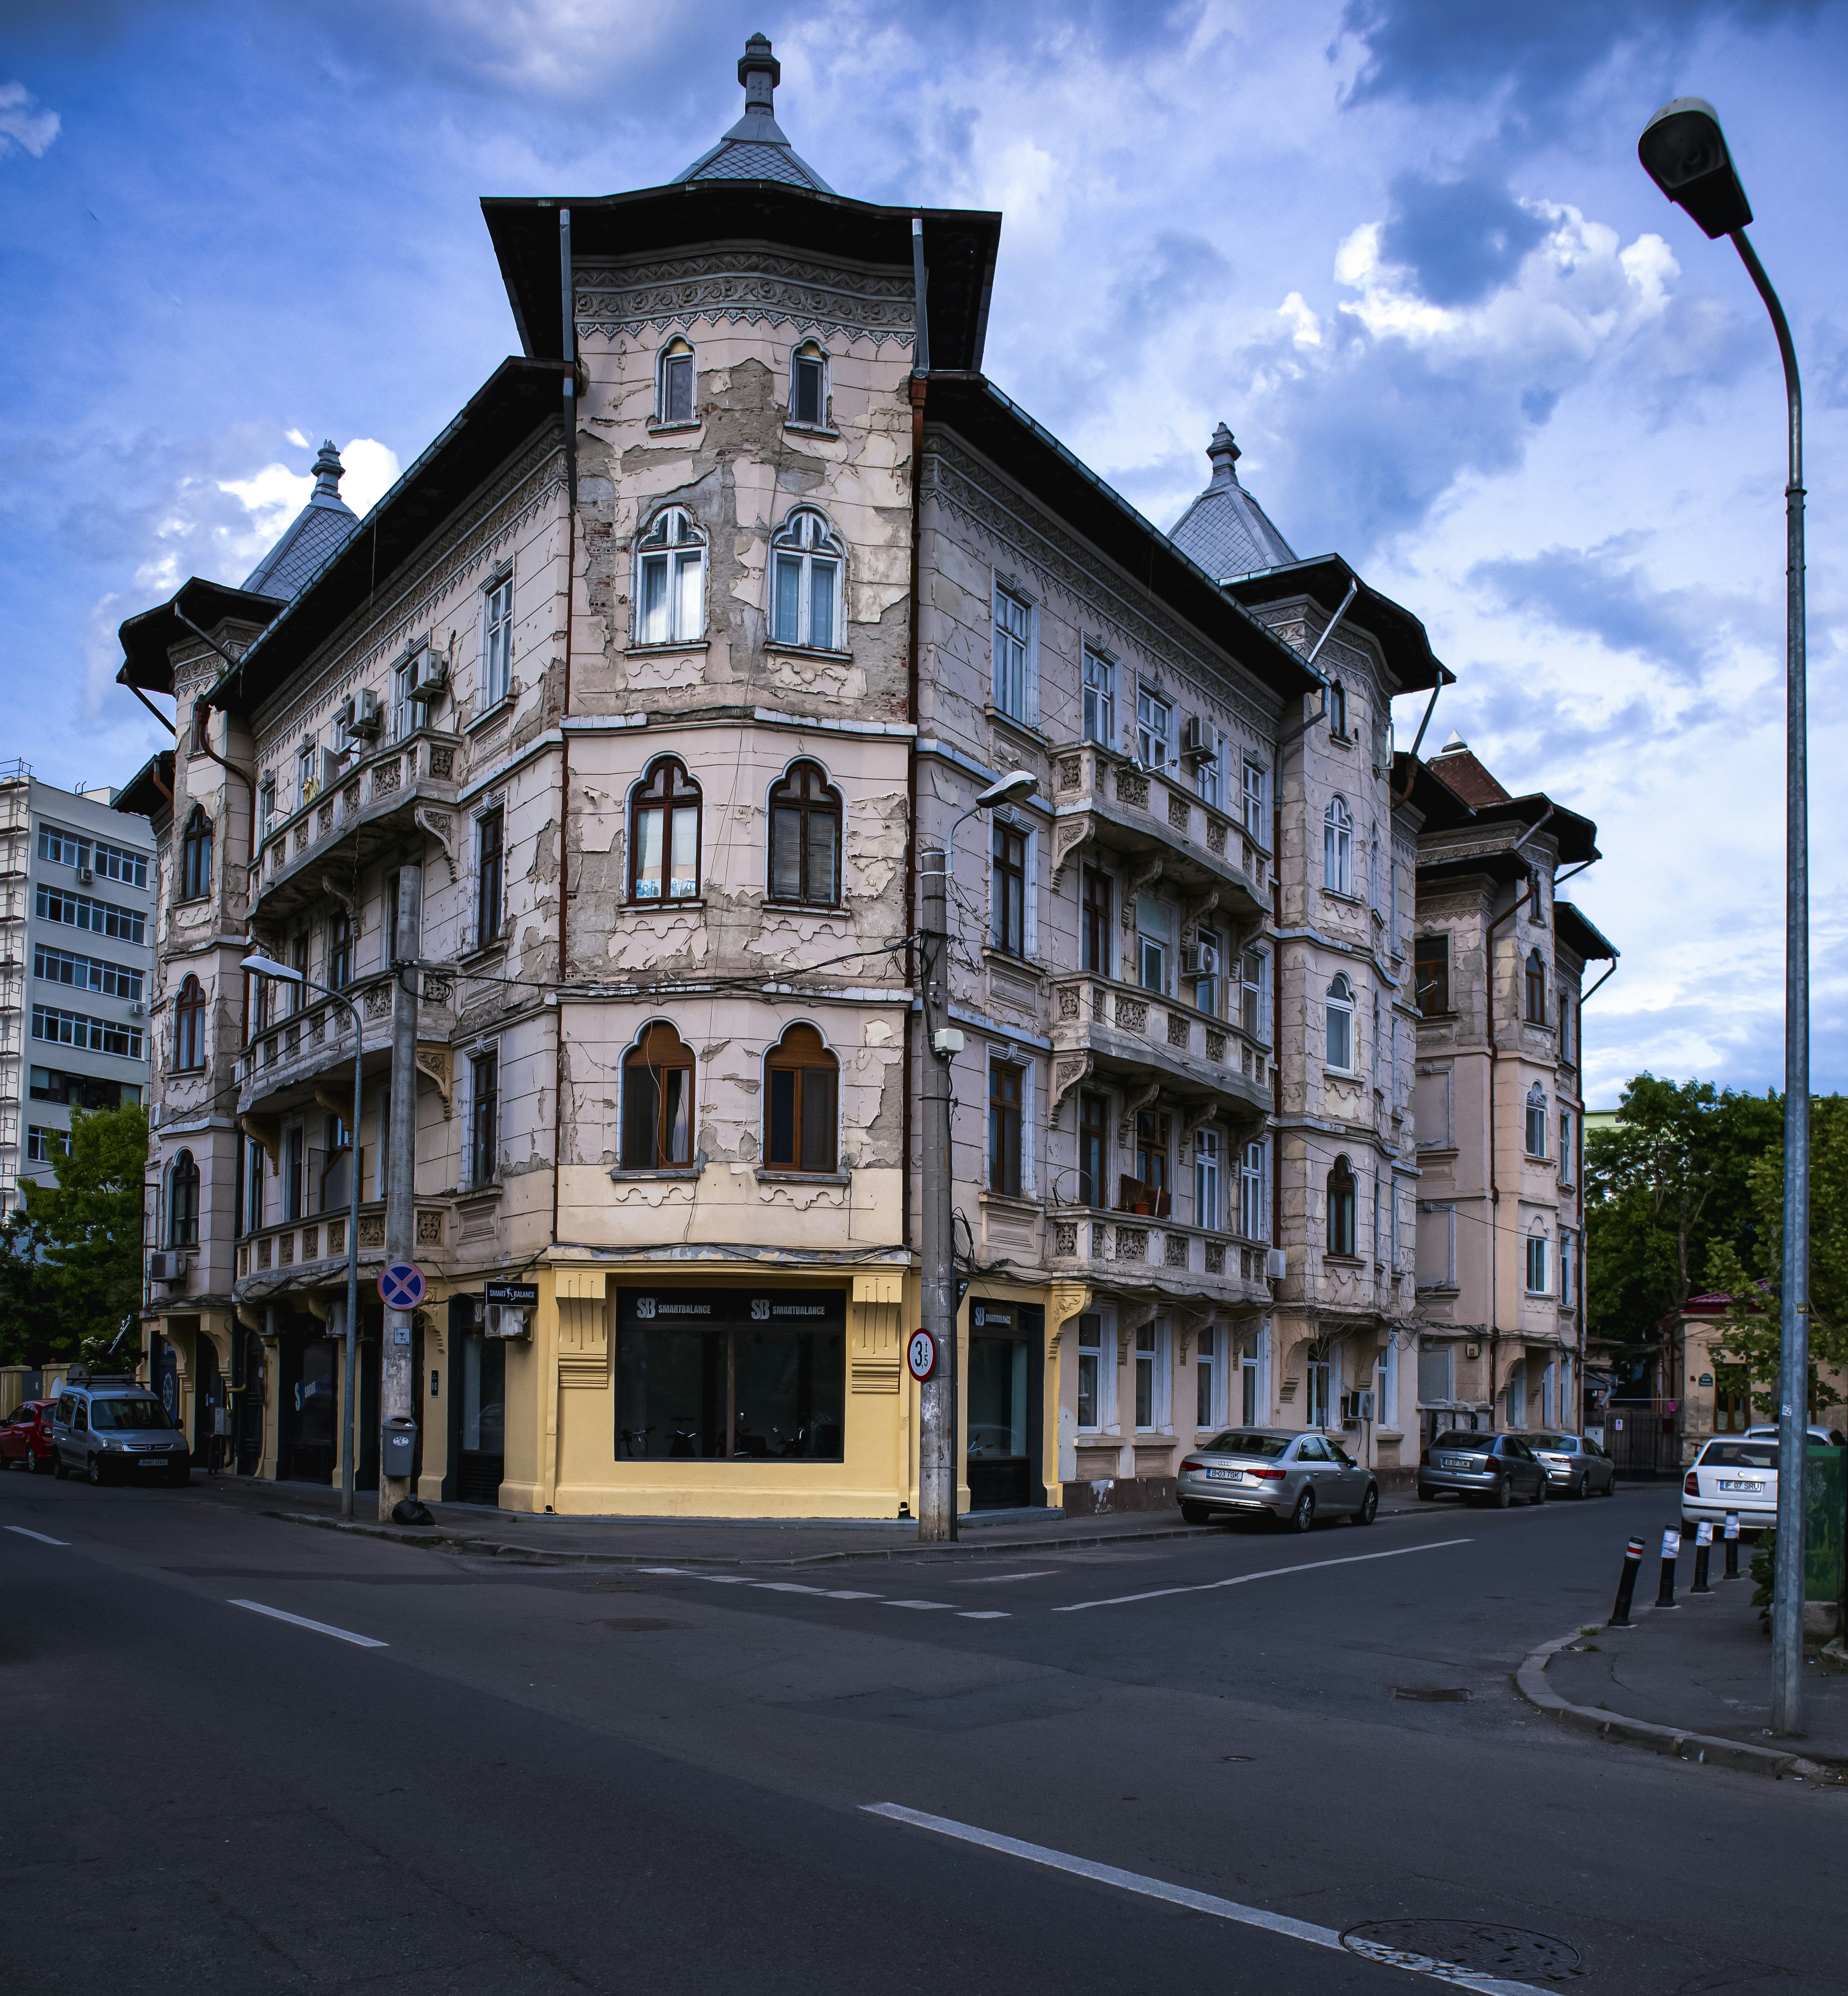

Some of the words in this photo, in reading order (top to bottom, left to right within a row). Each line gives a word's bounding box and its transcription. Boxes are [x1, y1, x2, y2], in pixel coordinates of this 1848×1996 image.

[637, 1298, 656, 1318] SB
[658, 1305, 711, 1314] SMARTBALANCE
[751, 1299, 770, 1319] SB
[772, 1306, 825, 1314] SMARTBALANCE
[975, 1307, 985, 1326] SB
